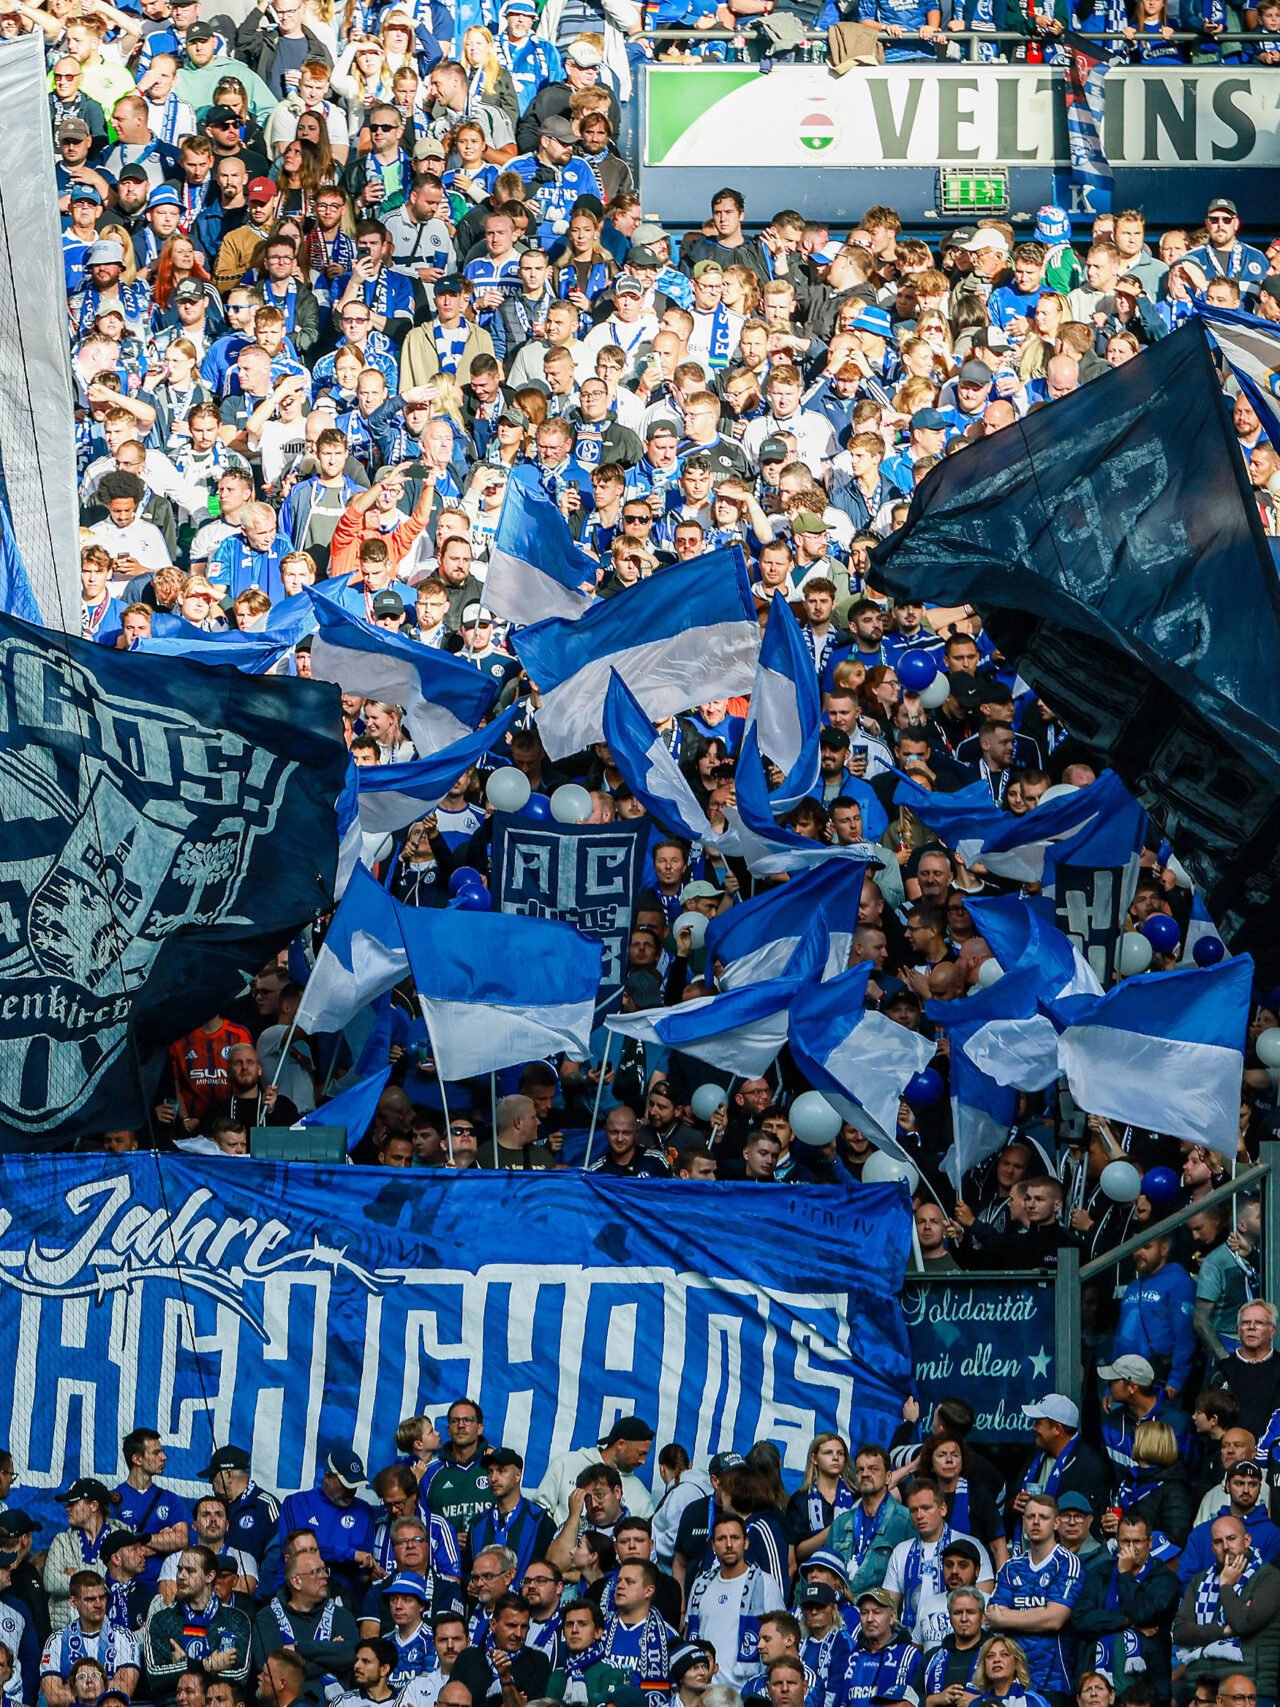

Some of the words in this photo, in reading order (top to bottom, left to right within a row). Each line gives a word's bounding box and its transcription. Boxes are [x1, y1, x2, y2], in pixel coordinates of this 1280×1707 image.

[865, 78, 1257, 161] VELTINS
[1068, 184, 1097, 214] K
[24, 1174, 295, 1286] Jahre
[901, 1285, 1038, 1326] Solidarität
[352, 1263, 854, 1507] CHAOS
[915, 1351, 954, 1381] mit
[960, 1342, 1022, 1378] allen
